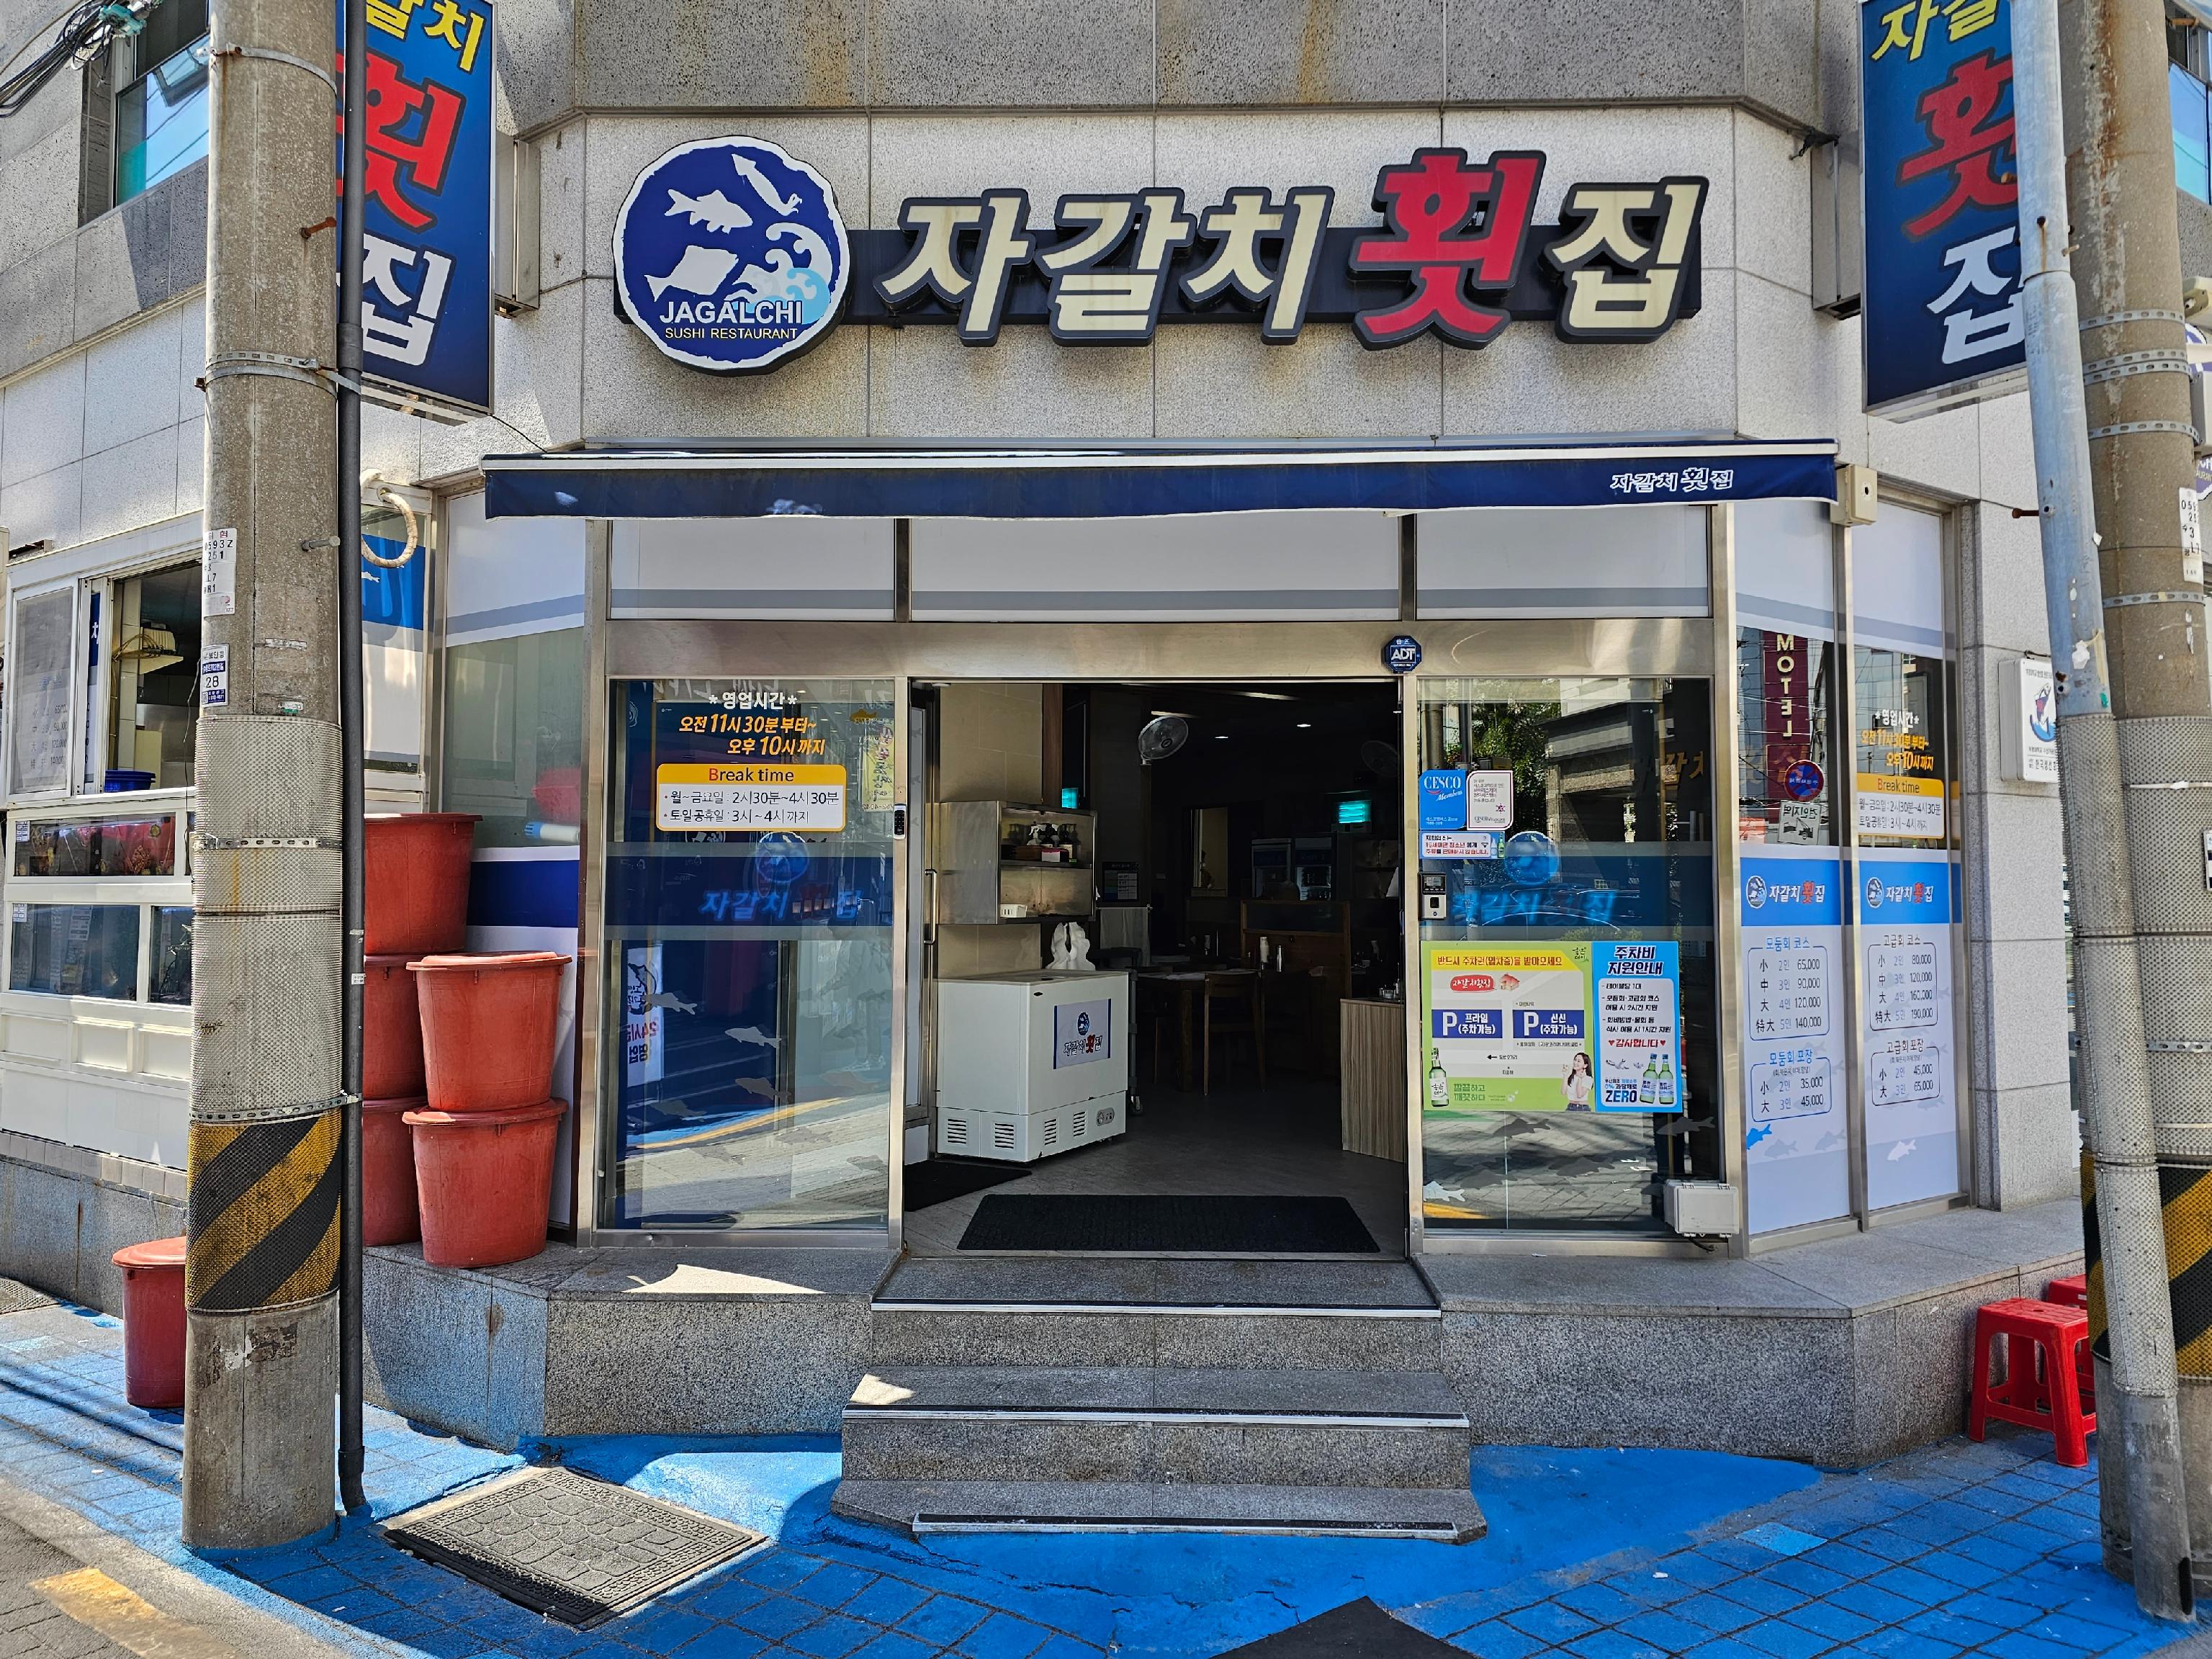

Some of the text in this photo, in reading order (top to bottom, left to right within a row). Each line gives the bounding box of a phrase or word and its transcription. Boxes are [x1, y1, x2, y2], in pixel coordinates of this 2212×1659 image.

[659, 301, 802, 324] JAGALCHI
[665, 328, 797, 339] SUSHI RESTAURANT
[1391, 647, 1416, 660] ADT
[206, 675, 220, 688] 28
[708, 768, 795, 782] Break time
[1424, 775, 1461, 789] CESCO
[1878, 778, 1920, 793] Break time
[1768, 880, 1825, 904] 자갈치횟집
[1885, 881, 1934, 904] 자갈치횟집
[1794, 935, 1811, 949] 코스
[1883, 934, 1921, 948] 고급회 코스
[1614, 945, 1656, 960] 주차비
[1437, 956, 1460, 966] 반드시
[1524, 956, 1563, 966] 받아오세요
[1797, 958, 1820, 971] 65,000
[1912, 955, 1932, 966] 80,000
[1607, 961, 1664, 976] 지원안내
[1797, 978, 1820, 991] 90,000
[1910, 972, 1933, 984] 120,000
[1910, 989, 1933, 1001] 160,000
[1794, 997, 1821, 1009] 120,000
[1465, 1013, 1488, 1024] 프라임
[1550, 1013, 1567, 1023] 신신
[1911, 1007, 1933, 1020] 190,000
[1458, 1024, 1496, 1035] (주차가능)
[1540, 1024, 1578, 1035] (주차가능)
[1795, 1017, 1822, 1029] 140,000
[1616, 1039, 1659, 1048] 감사합니다
[1887, 1038, 1924, 1054] 고급회 포장
[1797, 1049, 1813, 1064] 포장
[1913, 1064, 1933, 1075] 45,000
[1800, 1076, 1823, 1089] 35,000
[1914, 1080, 1933, 1092] 65,000
[1605, 1090, 1637, 1103] ZERO
[1801, 1094, 1824, 1107] 45,000
